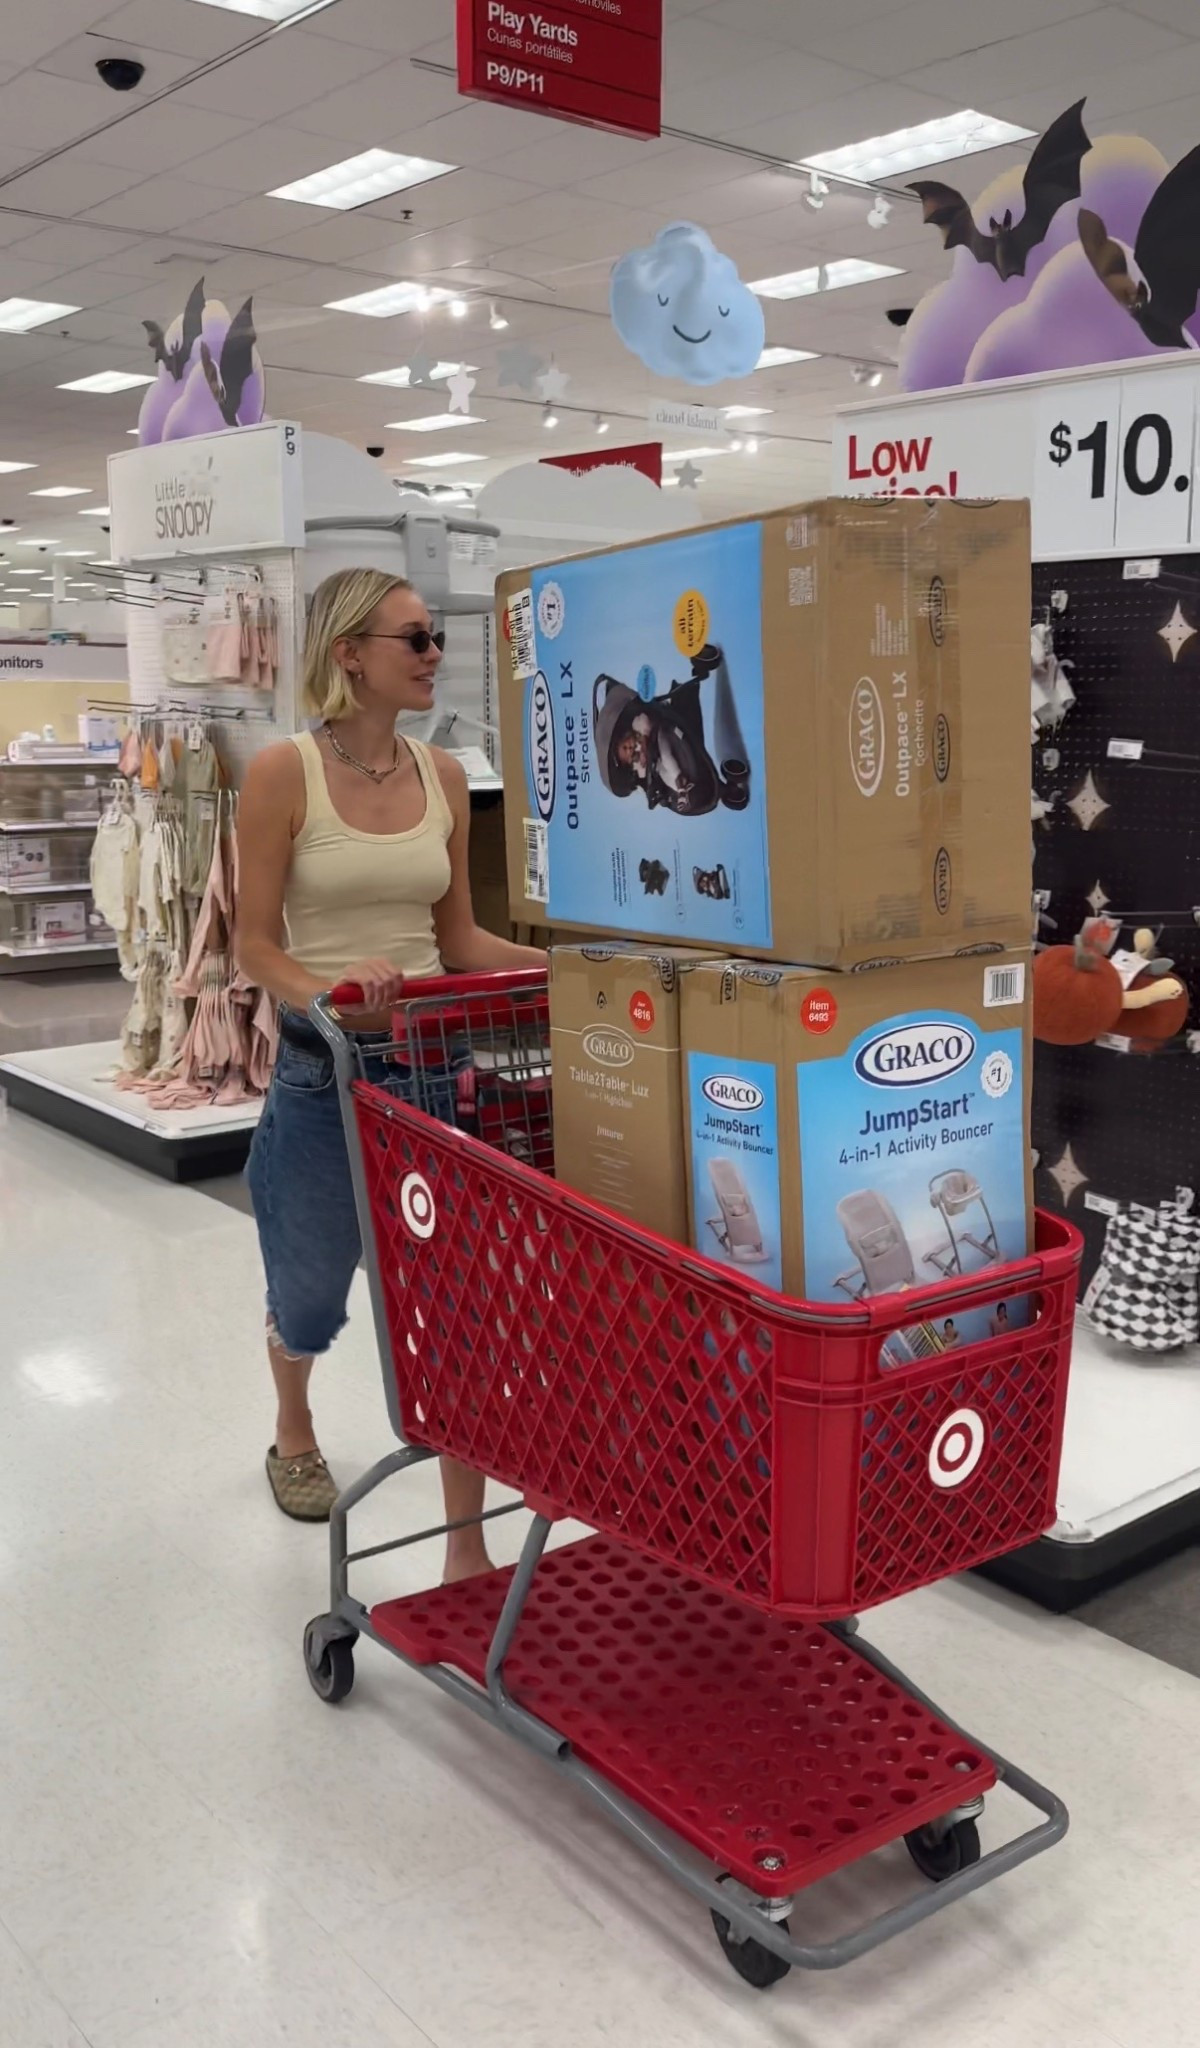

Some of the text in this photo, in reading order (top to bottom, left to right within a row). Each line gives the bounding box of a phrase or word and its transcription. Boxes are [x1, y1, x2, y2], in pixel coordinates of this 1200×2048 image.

[487, 1, 578, 46] Play Yards
[486, 27, 574, 64] Cunas portátiles
[486, 61, 544, 94] P9/P11
[848, 434, 933, 480] Low
[154, 477, 186, 502] Little
[155, 499, 214, 540] SNOOPY
[678, 617, 687, 634] all
[686, 598, 695, 648] terrain
[892, 671, 908, 699] LX
[534, 686, 550, 802] GRACO
[559, 660, 580, 831] Outpace LX
[578, 708, 591, 784] Stroller
[857, 688, 877, 780] GRACO
[914, 699, 926, 768] Cochecito
[632, 1008, 652, 1022] 4816
[808, 1012, 830, 1023] 6493
[590, 1037, 630, 1060] GRACO
[874, 1035, 963, 1073] GRACO
[631, 1080, 650, 1098] Lux
[709, 1081, 758, 1105] GRACO
[716, 1135, 742, 1151] Activity
[742, 1140, 774, 1156] Bouncer
[838, 1122, 995, 1165] 4-in-1 Activity Bouncer
